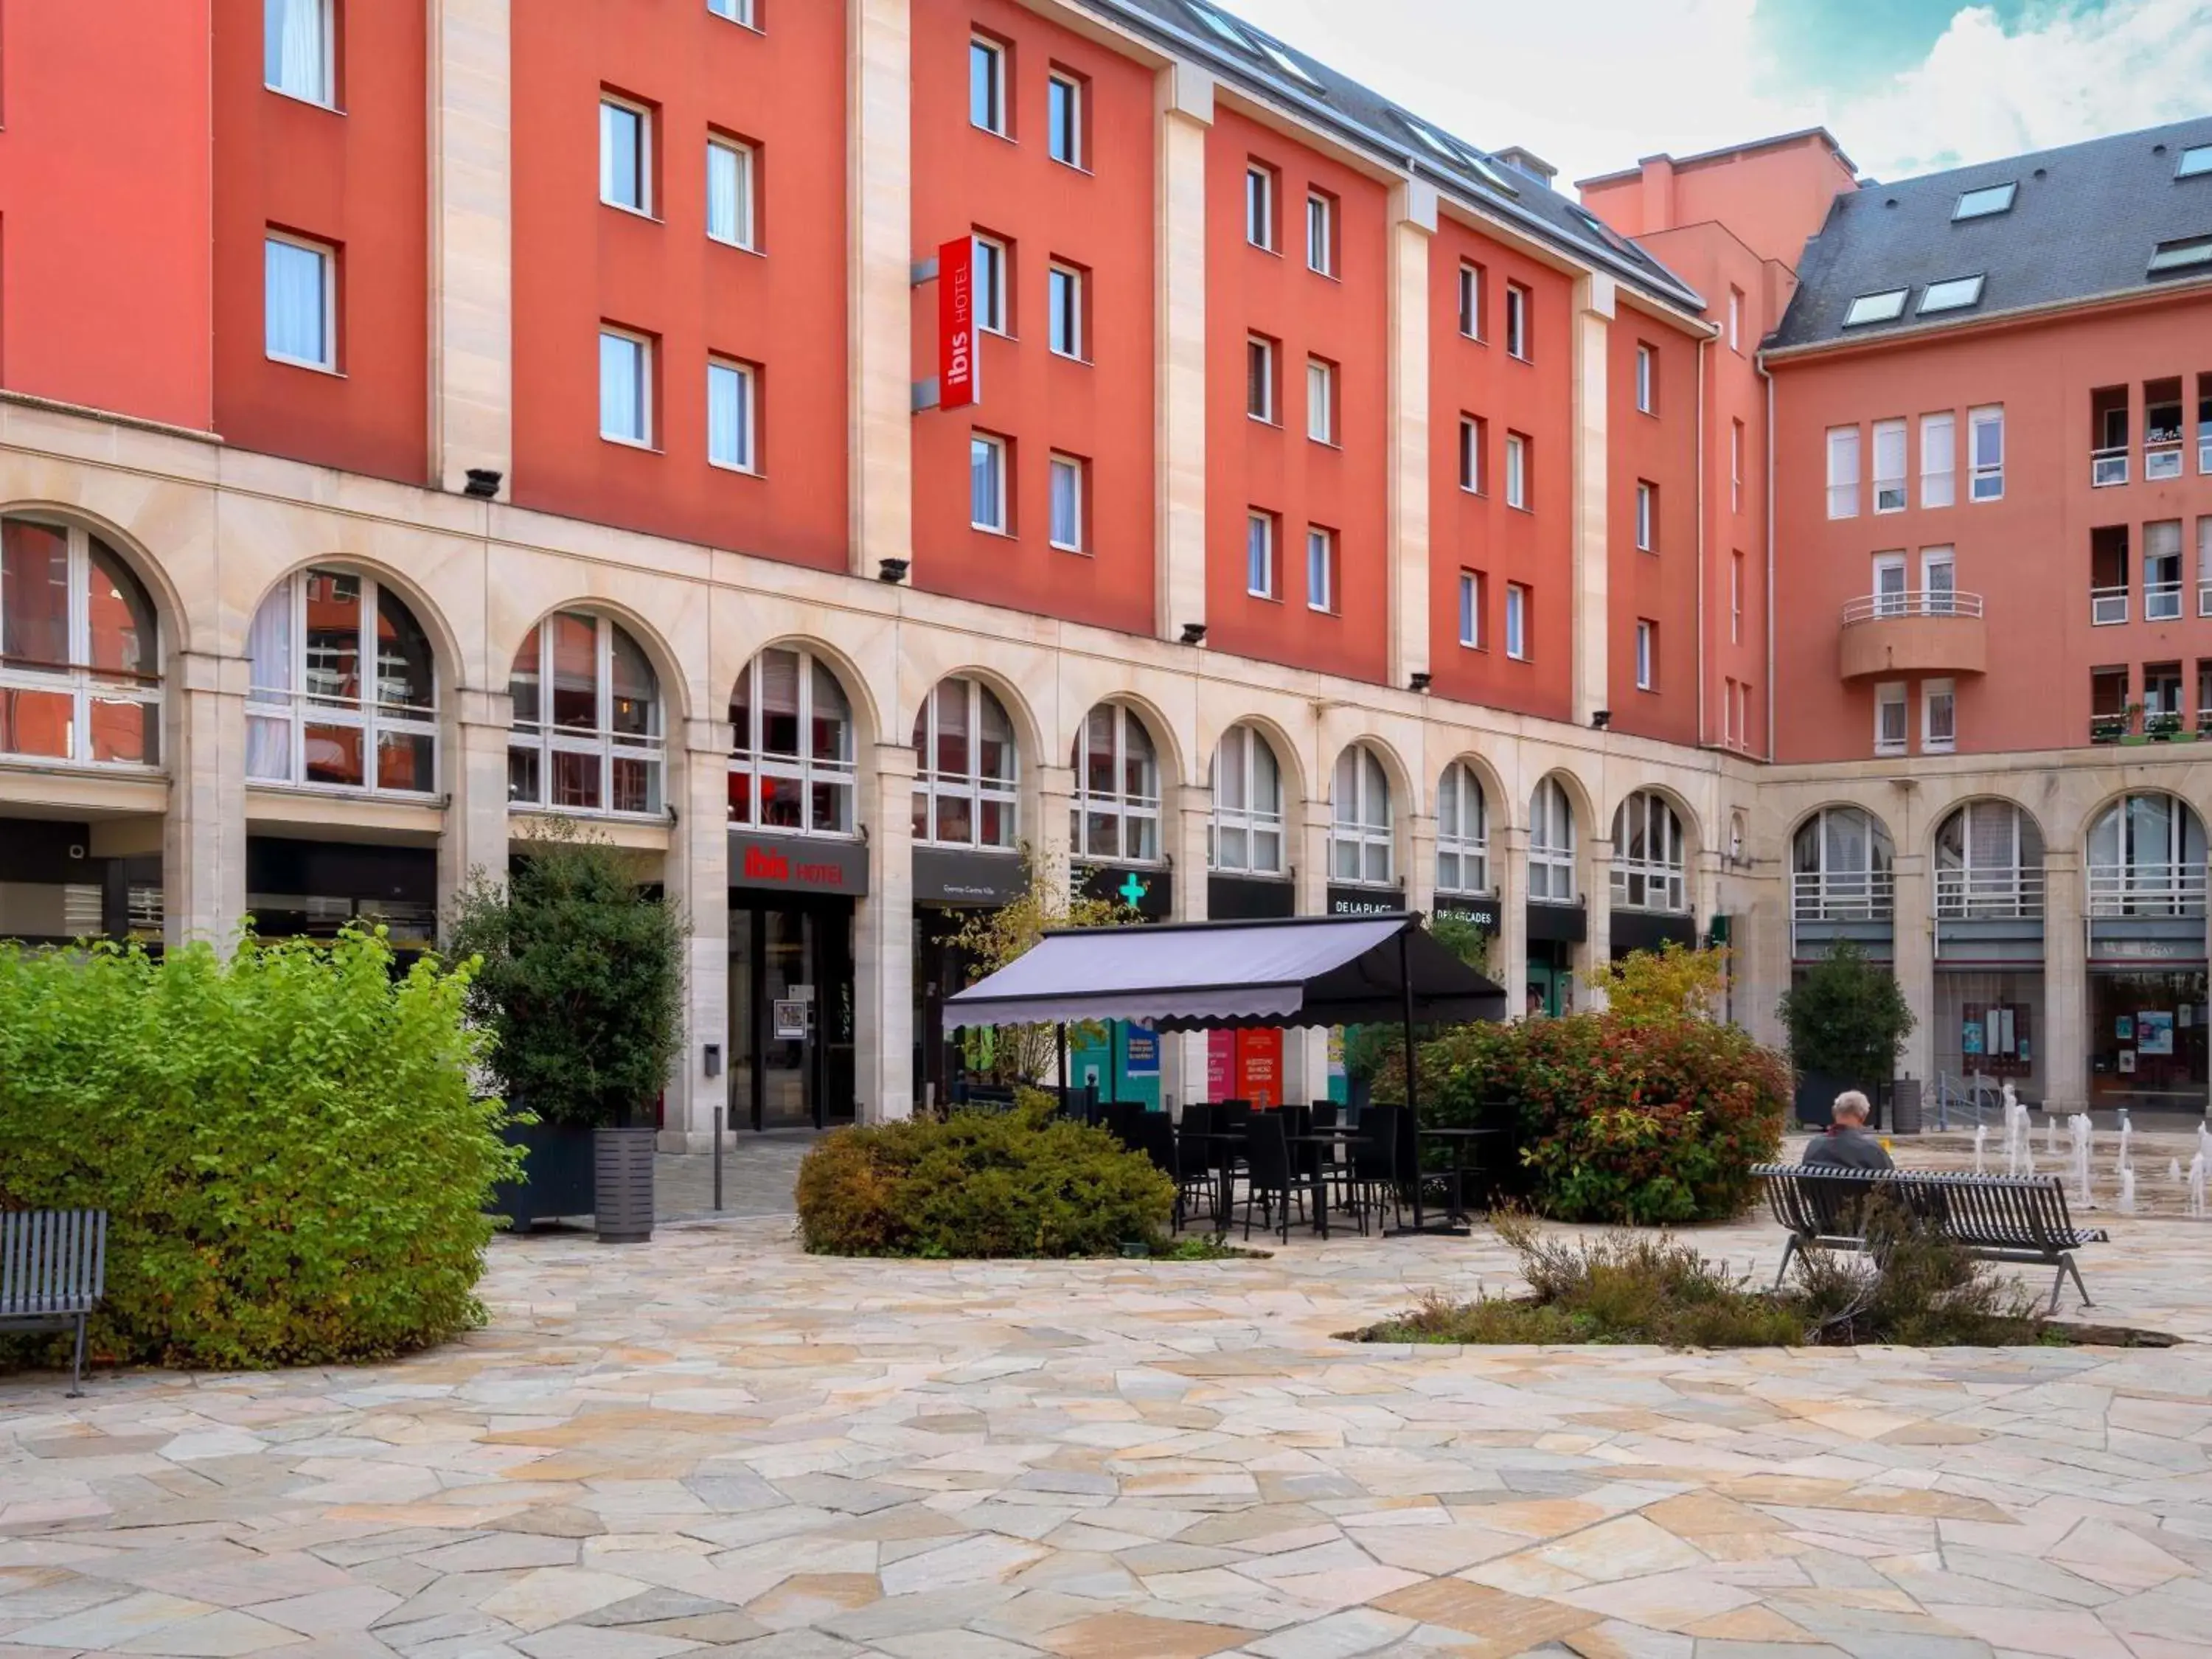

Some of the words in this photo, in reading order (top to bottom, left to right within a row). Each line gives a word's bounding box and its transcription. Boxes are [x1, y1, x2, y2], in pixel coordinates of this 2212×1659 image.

[955, 262, 968, 323] HOTEL
[948, 331, 968, 386] ibis
[745, 846, 788, 883] ibis
[796, 862, 843, 886] HOTEL
[1335, 901, 1349, 912] DE
[1350, 902, 1362, 913] LA
